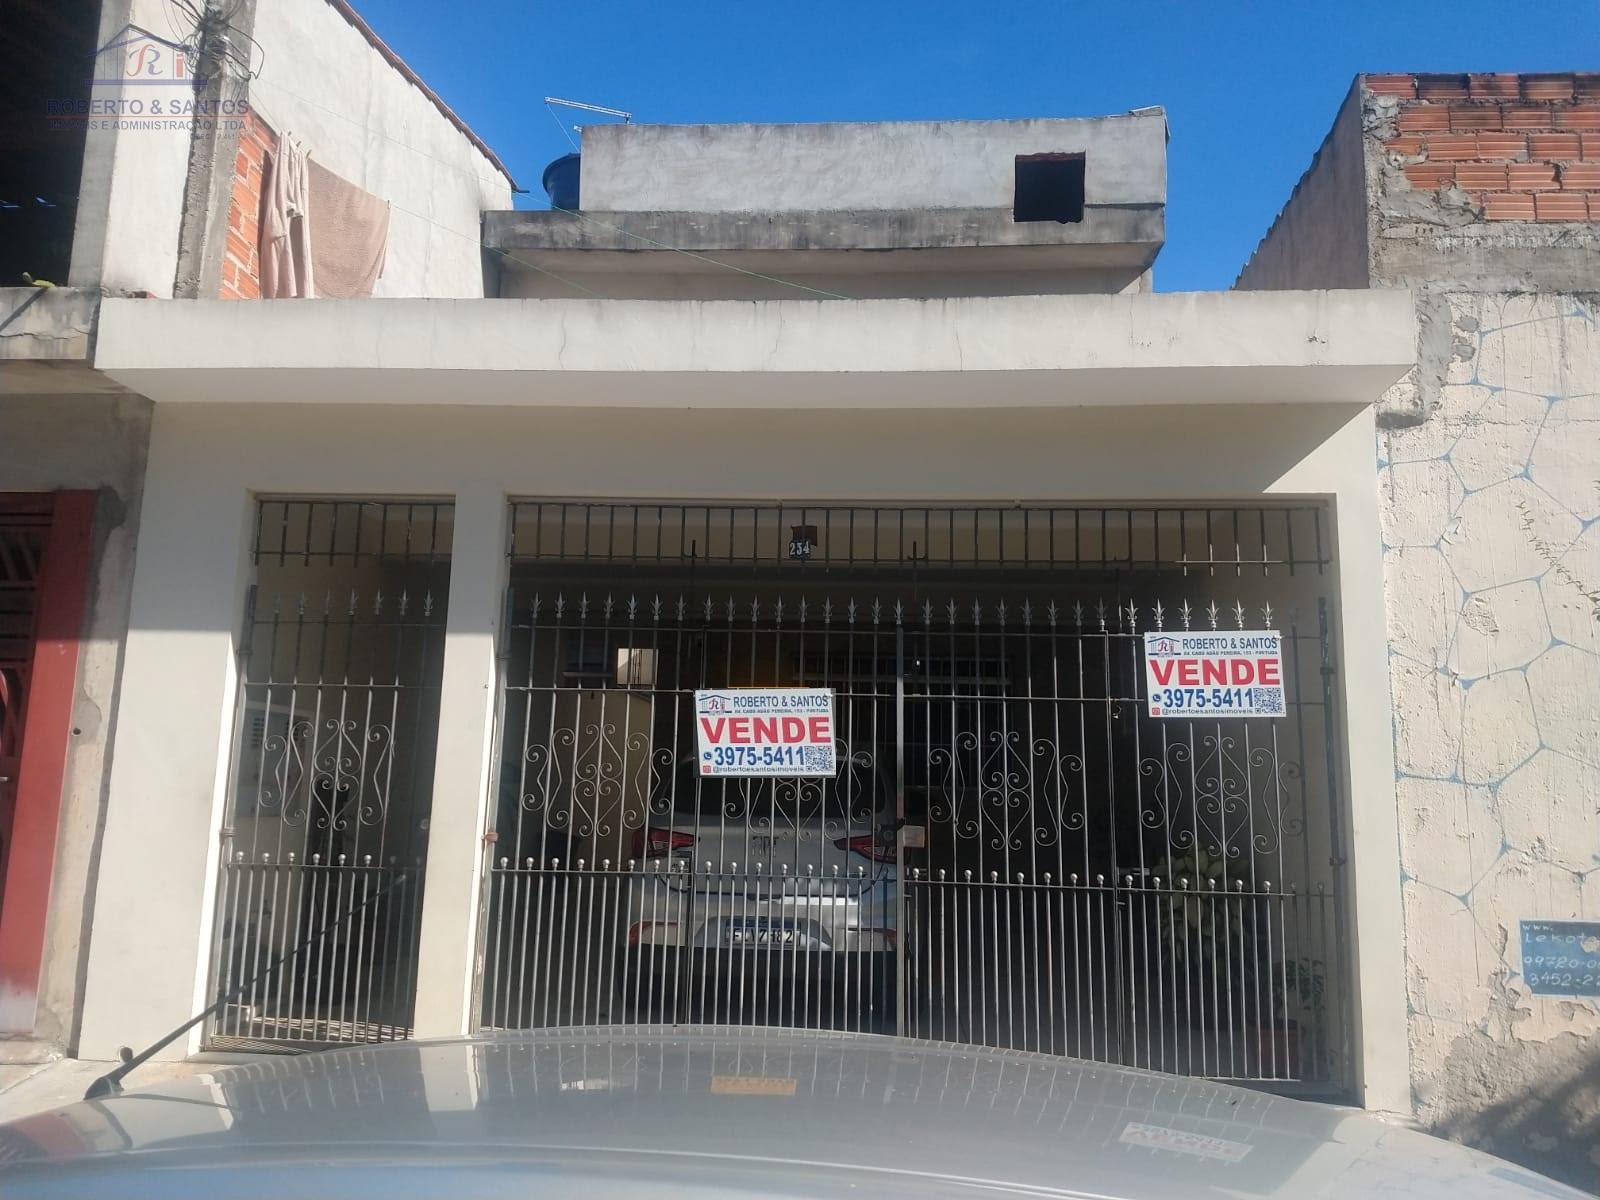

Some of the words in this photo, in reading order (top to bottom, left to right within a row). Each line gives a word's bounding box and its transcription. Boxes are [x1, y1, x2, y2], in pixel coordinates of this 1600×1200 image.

[1182, 638, 1228, 650] ROBERTO
[1231, 638, 1237, 649] &
[1240, 637, 1278, 649] SANTOS
[1149, 659, 1281, 686] VENDE
[733, 695, 778, 707] ROBERTO
[781, 695, 788, 707] &
[790, 694, 829, 706] SANTOS
[1162, 687, 1254, 708] 3975-5411
[699, 717, 832, 744] VENDE
[713, 745, 805, 766] 3975-5411
